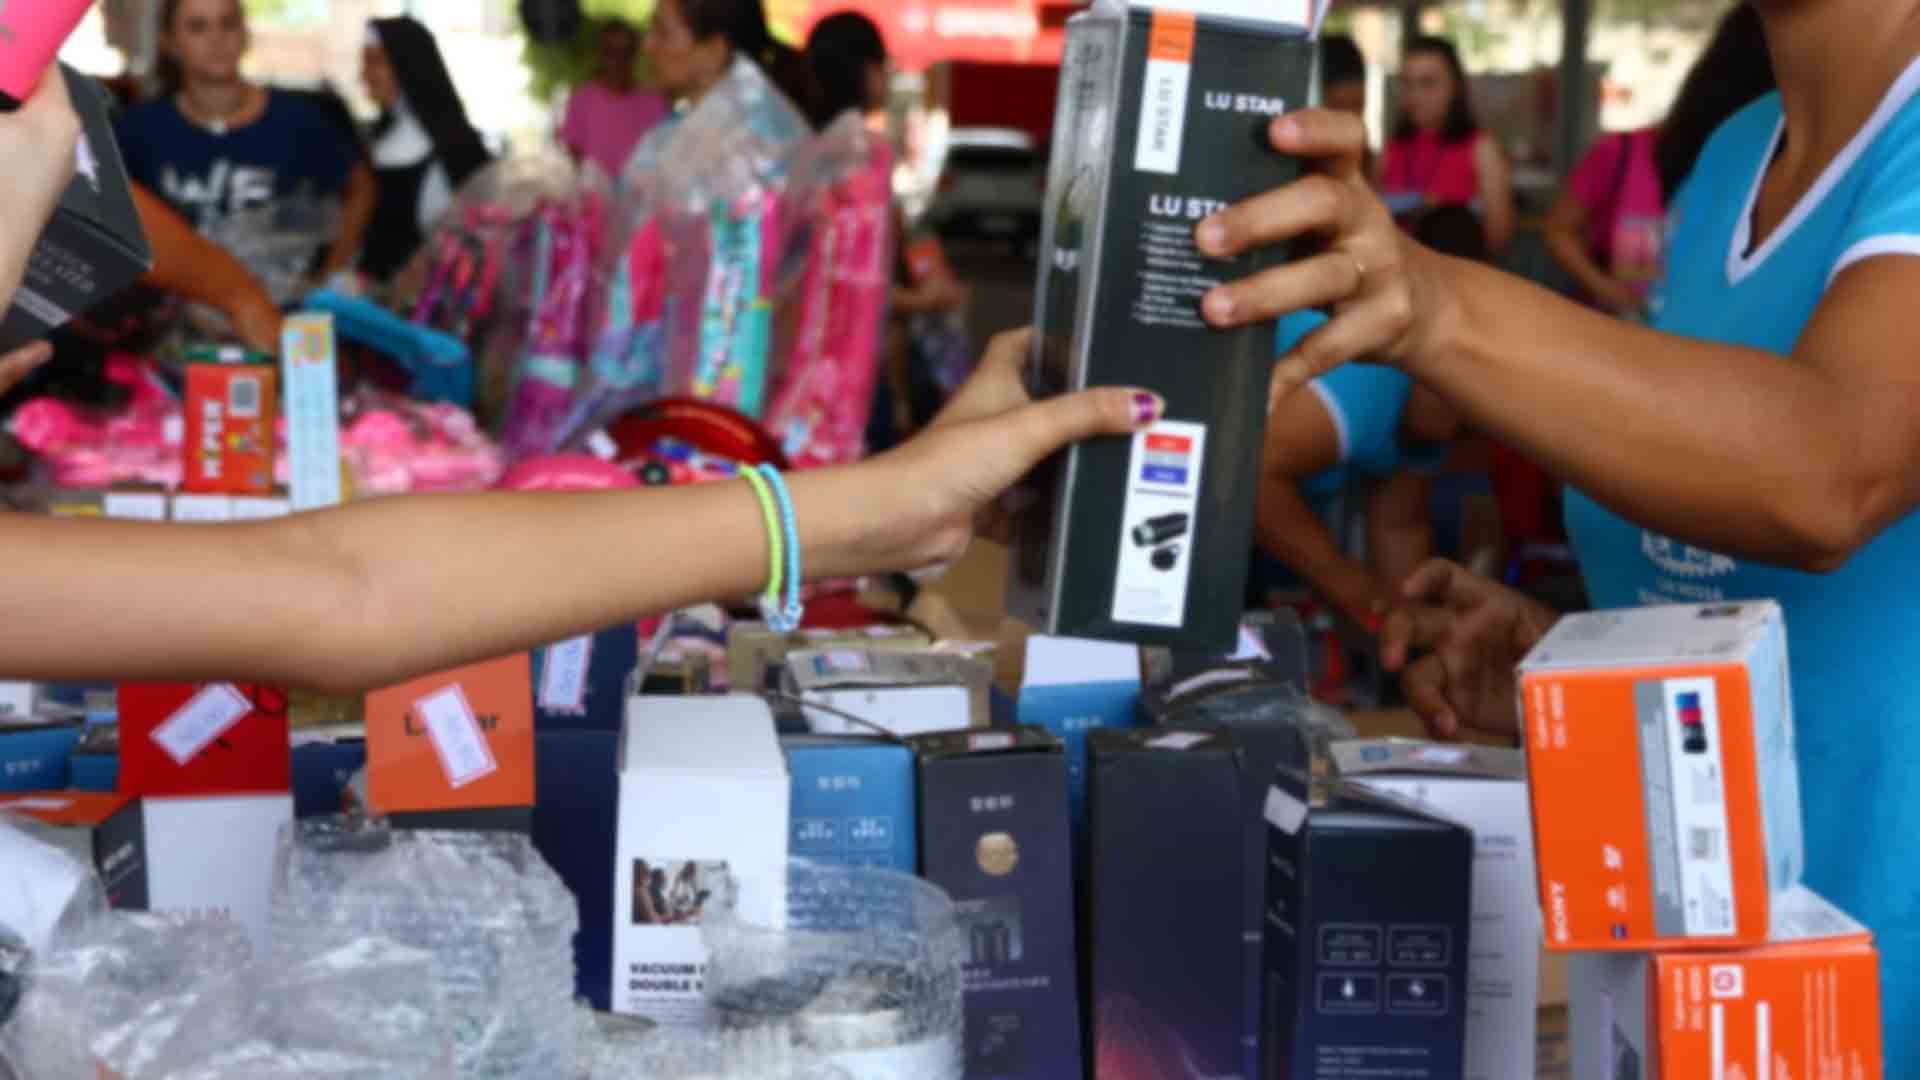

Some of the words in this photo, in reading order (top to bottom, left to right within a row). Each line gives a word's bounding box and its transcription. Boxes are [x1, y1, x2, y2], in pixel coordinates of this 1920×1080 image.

[1205, 91, 1230, 109] LU
[1234, 95, 1285, 115] STAR
[1149, 193, 1182, 217] LU
[1186, 198, 1227, 219] ST
[1547, 881, 1569, 942] SONY
[629, 962, 697, 976] VACUUM
[628, 979, 695, 993] DOUBLE
